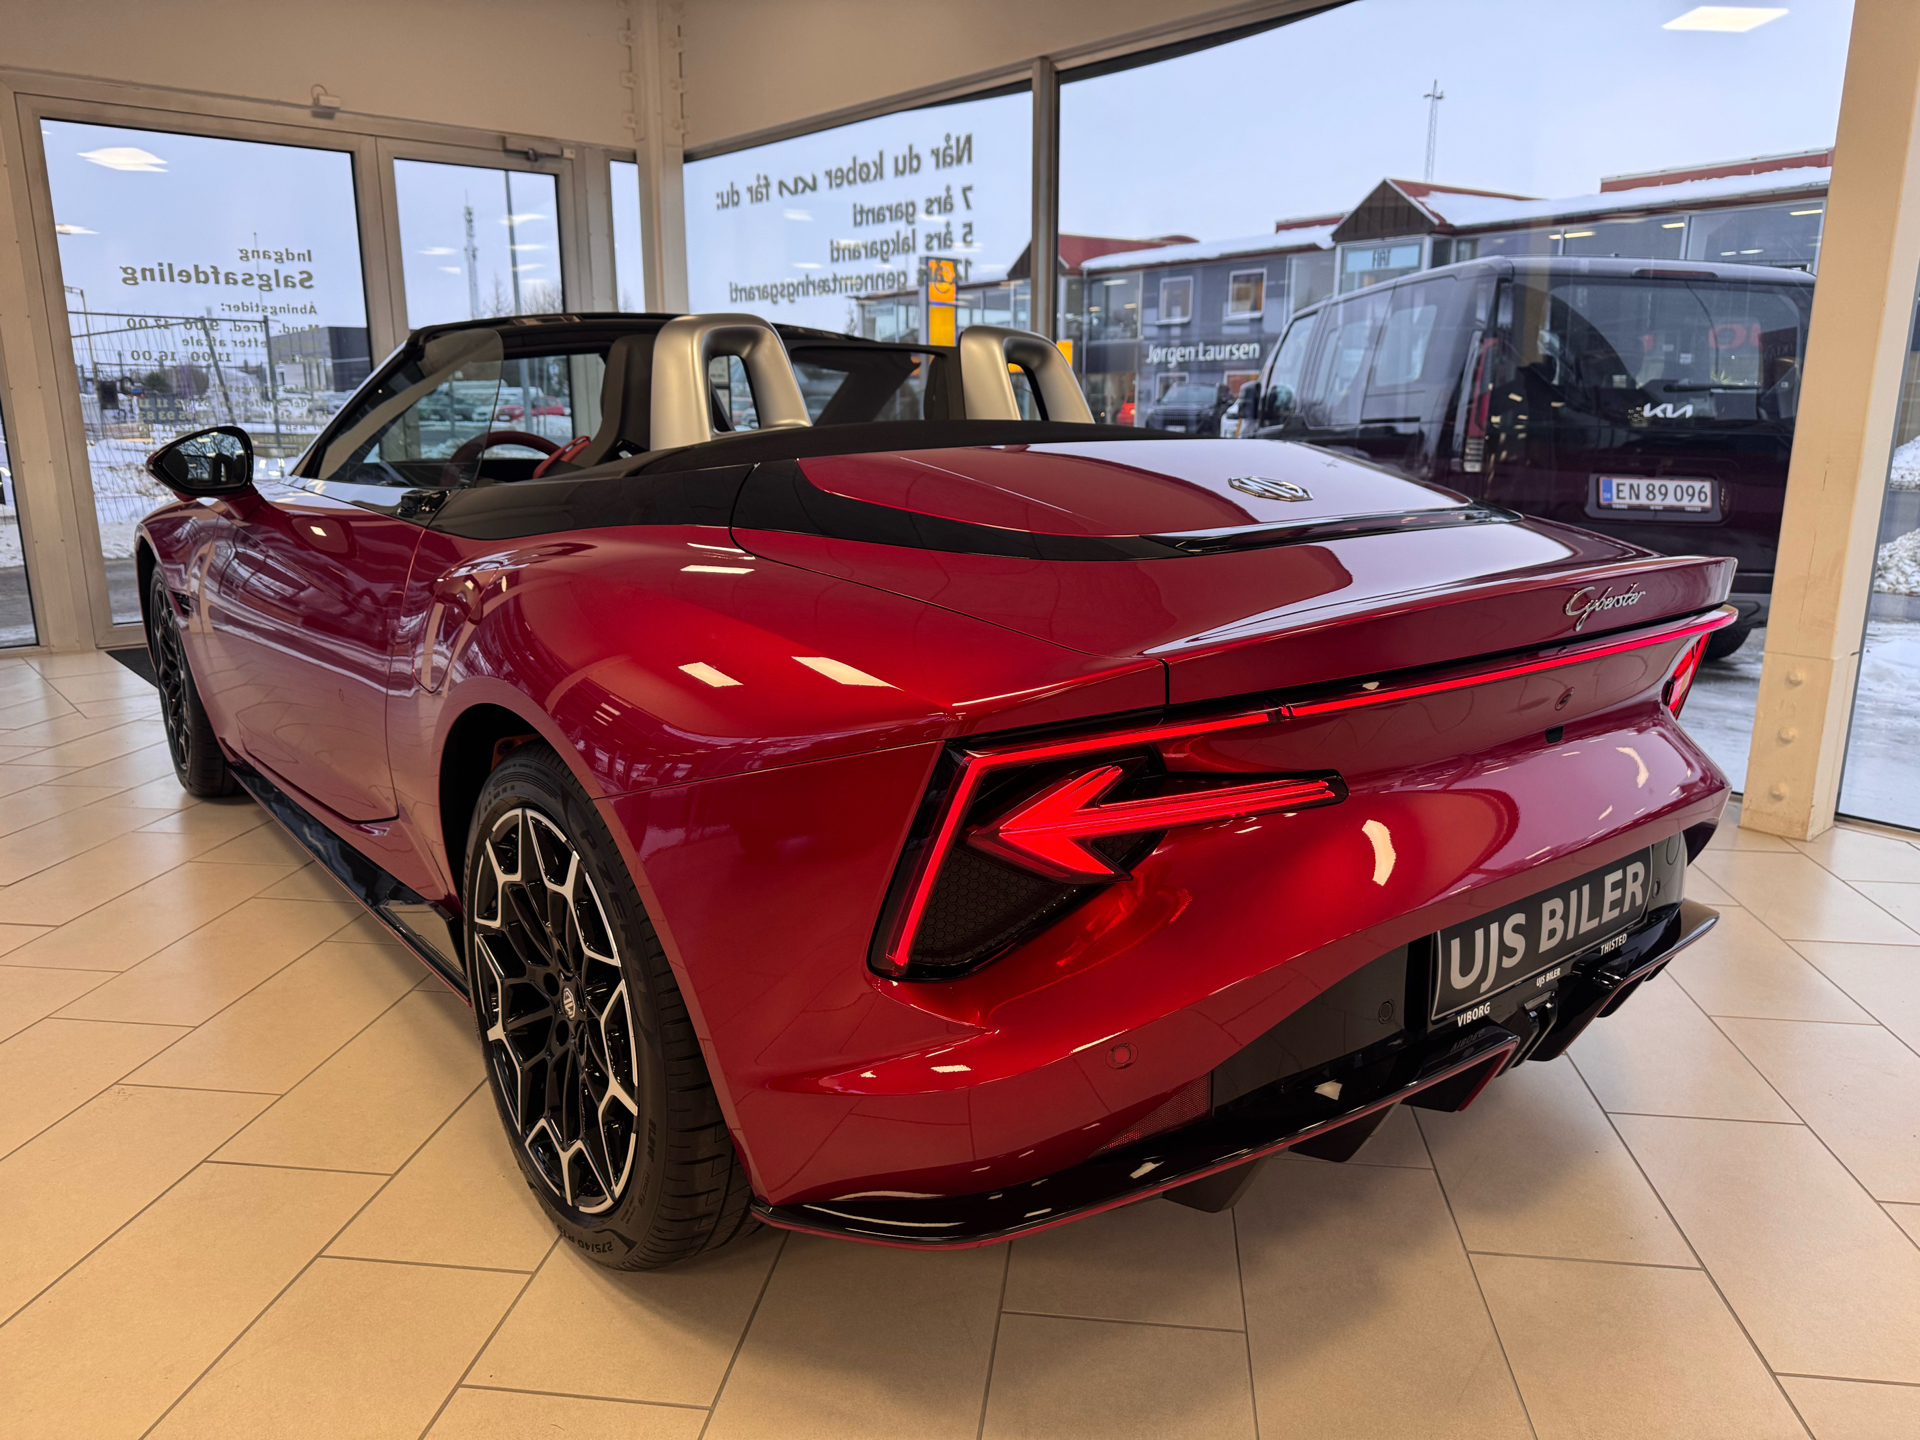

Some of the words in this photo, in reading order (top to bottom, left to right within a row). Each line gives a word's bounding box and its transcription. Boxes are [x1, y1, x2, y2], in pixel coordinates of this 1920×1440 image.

[1373, 248, 1392, 267] FIAT
[1146, 343, 1195, 368] Jørgen
[1198, 342, 1260, 361] Laursen
[1643, 403, 1693, 418] KIA
[1615, 482, 1641, 501] EN
[1646, 483, 1669, 502] 89
[1674, 484, 1708, 503] 096
[1565, 582, 1646, 632] Cyberster
[1450, 913, 1526, 993] UJS
[1538, 861, 1645, 954] BILER
[1600, 933, 1628, 956] THISTED
[1536, 975, 1546, 988] UJS
[1545, 967, 1561, 982] BILER
[1456, 1002, 1491, 1027] VIBORG
